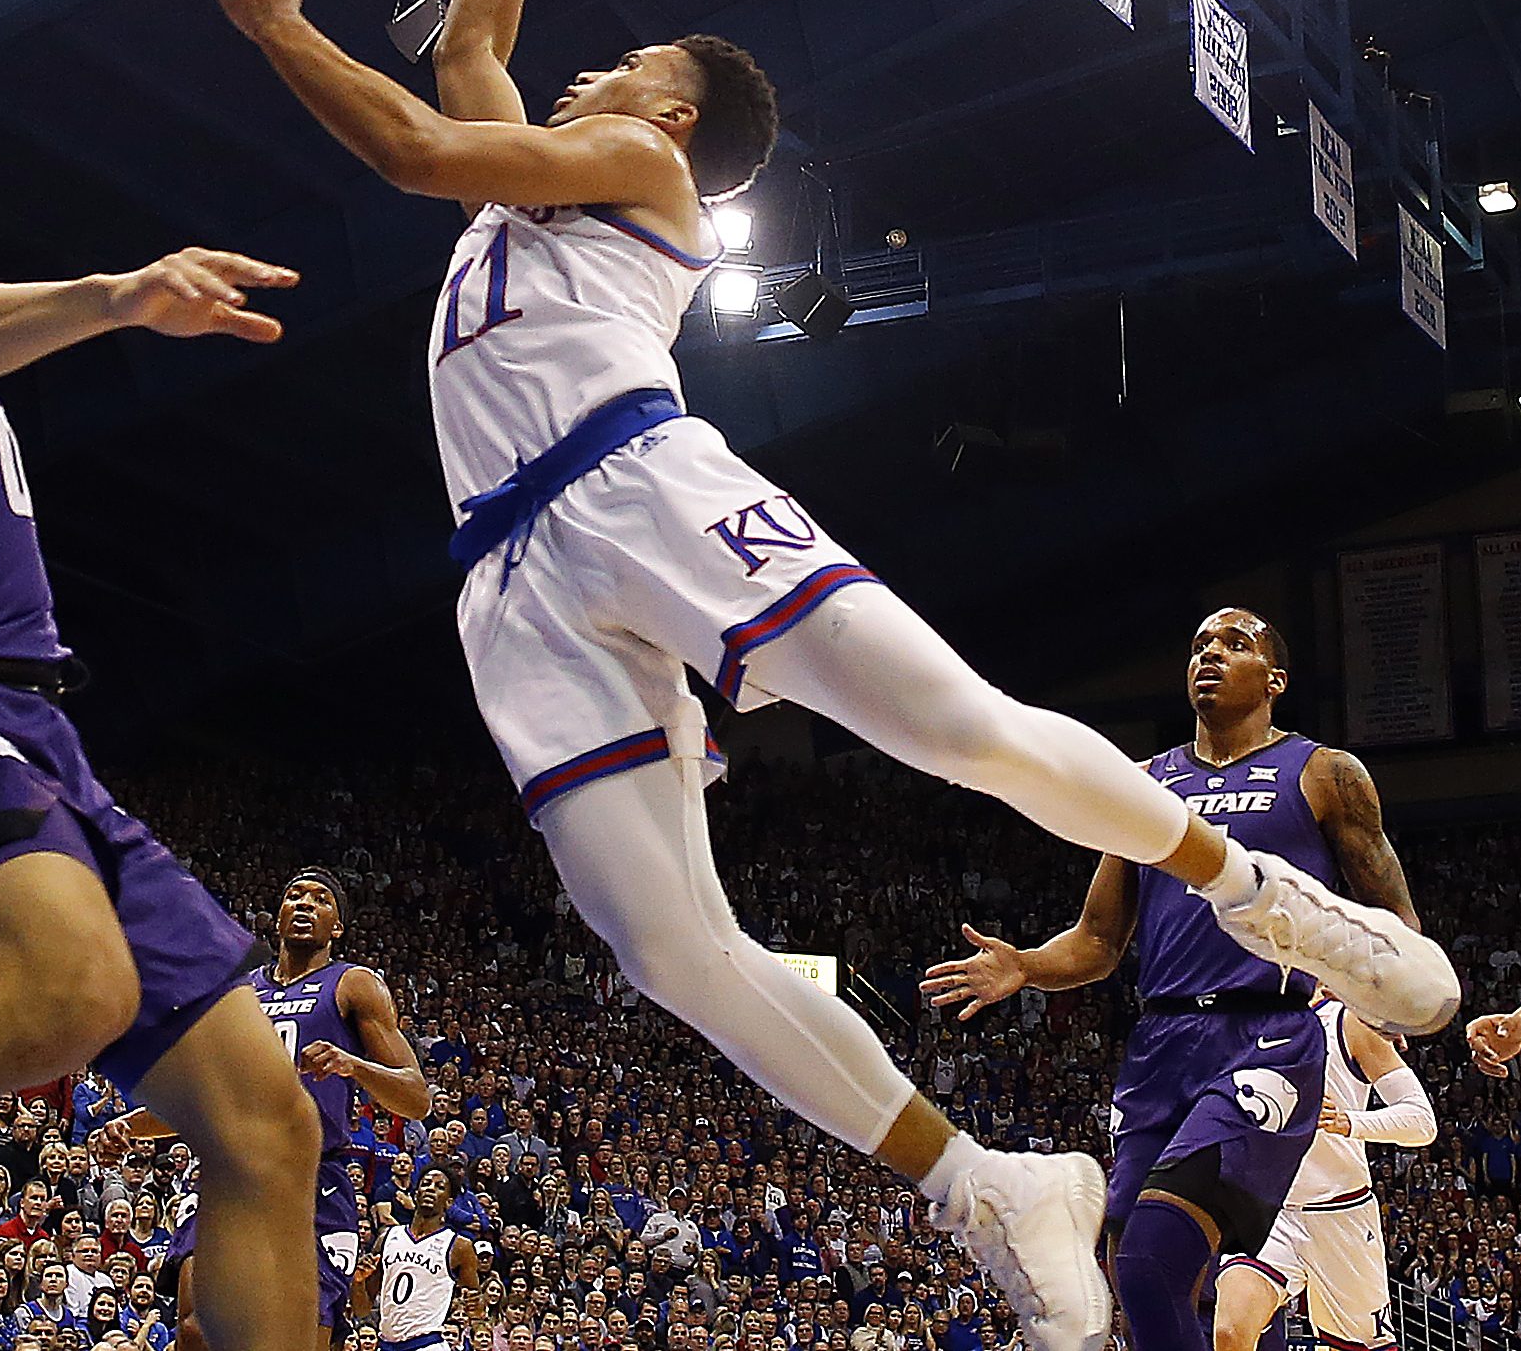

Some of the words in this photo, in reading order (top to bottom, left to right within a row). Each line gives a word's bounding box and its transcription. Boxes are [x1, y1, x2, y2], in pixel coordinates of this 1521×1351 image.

[705, 494, 817, 577] KU
[383, 1250, 442, 1275] KANSAS
[392, 1271, 414, 1305] 0
